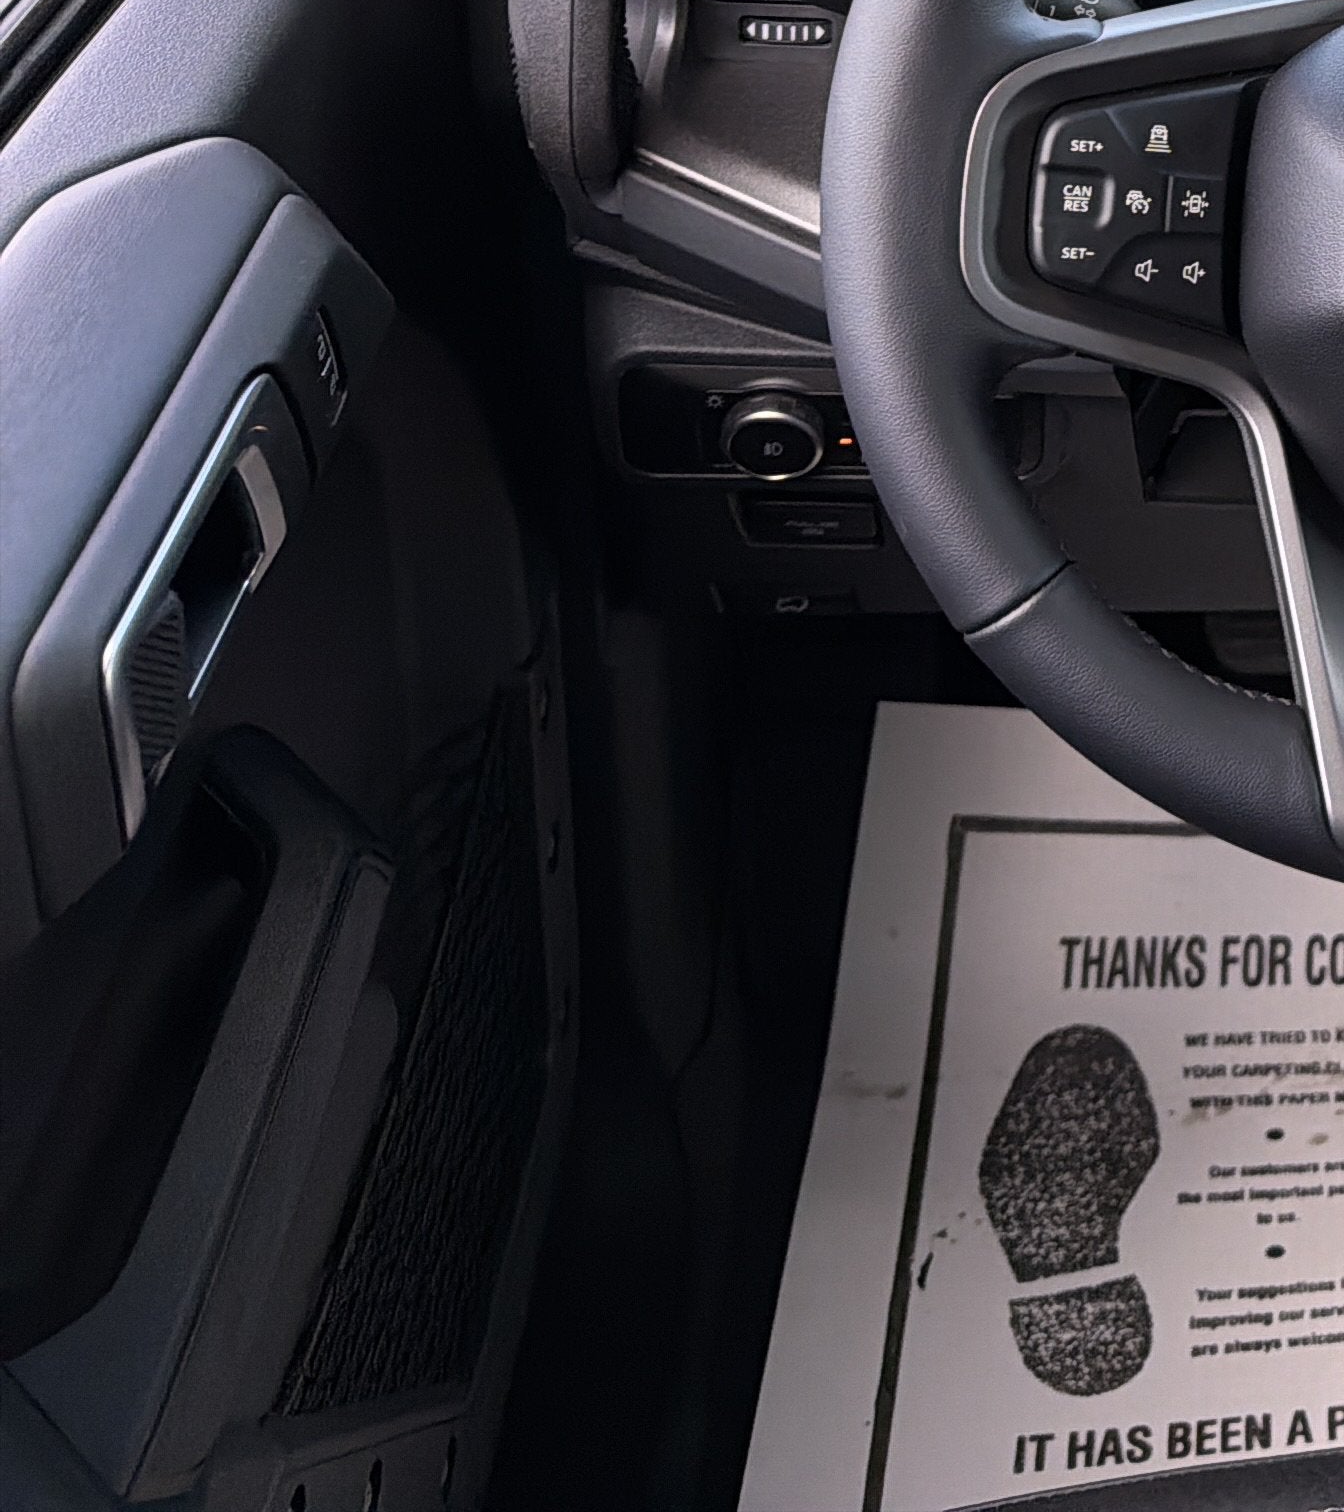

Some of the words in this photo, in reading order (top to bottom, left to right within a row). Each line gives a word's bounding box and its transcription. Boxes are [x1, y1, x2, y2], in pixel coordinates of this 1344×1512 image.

[1062, 184, 1092, 198] CAN
[1063, 199, 1089, 214] RES
[1059, 934, 1206, 991] THANKS
[1218, 934, 1292, 989] FOR
[1260, 1030, 1306, 1045] TRIED
[1310, 1029, 1331, 1043] TO
[1278, 1092, 1330, 1106] PAPER
[1013, 1432, 1052, 1477] IT
[1066, 1425, 1154, 1471] HAS
[1165, 1412, 1273, 1462] BEEN
[1284, 1406, 1315, 1449] A
